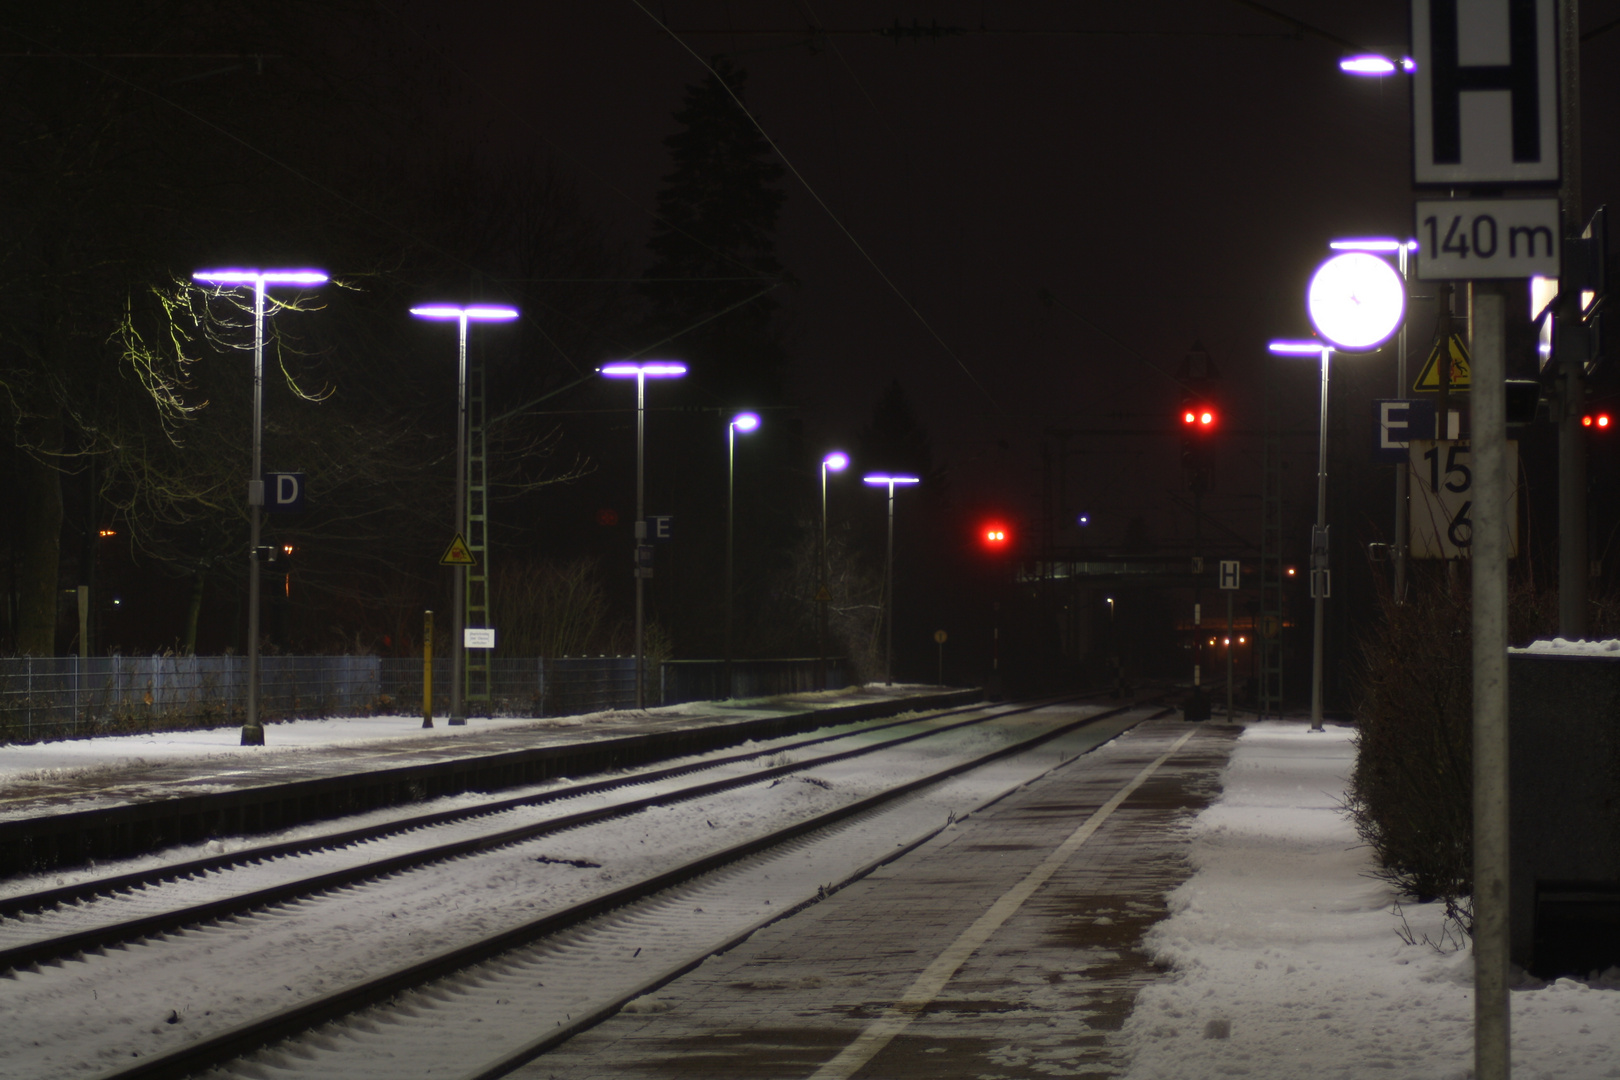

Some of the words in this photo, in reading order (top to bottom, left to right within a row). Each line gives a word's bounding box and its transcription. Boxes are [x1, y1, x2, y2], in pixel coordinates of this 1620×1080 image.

[1430, 0, 1541, 164] H
[1424, 215, 1497, 259] 140
[1509, 226, 1553, 257] m
[1381, 403, 1410, 448] E
[277, 475, 298, 504] D
[657, 518, 670, 537] E
[1448, 501, 1472, 547] 6
[1223, 564, 1237, 586] H
